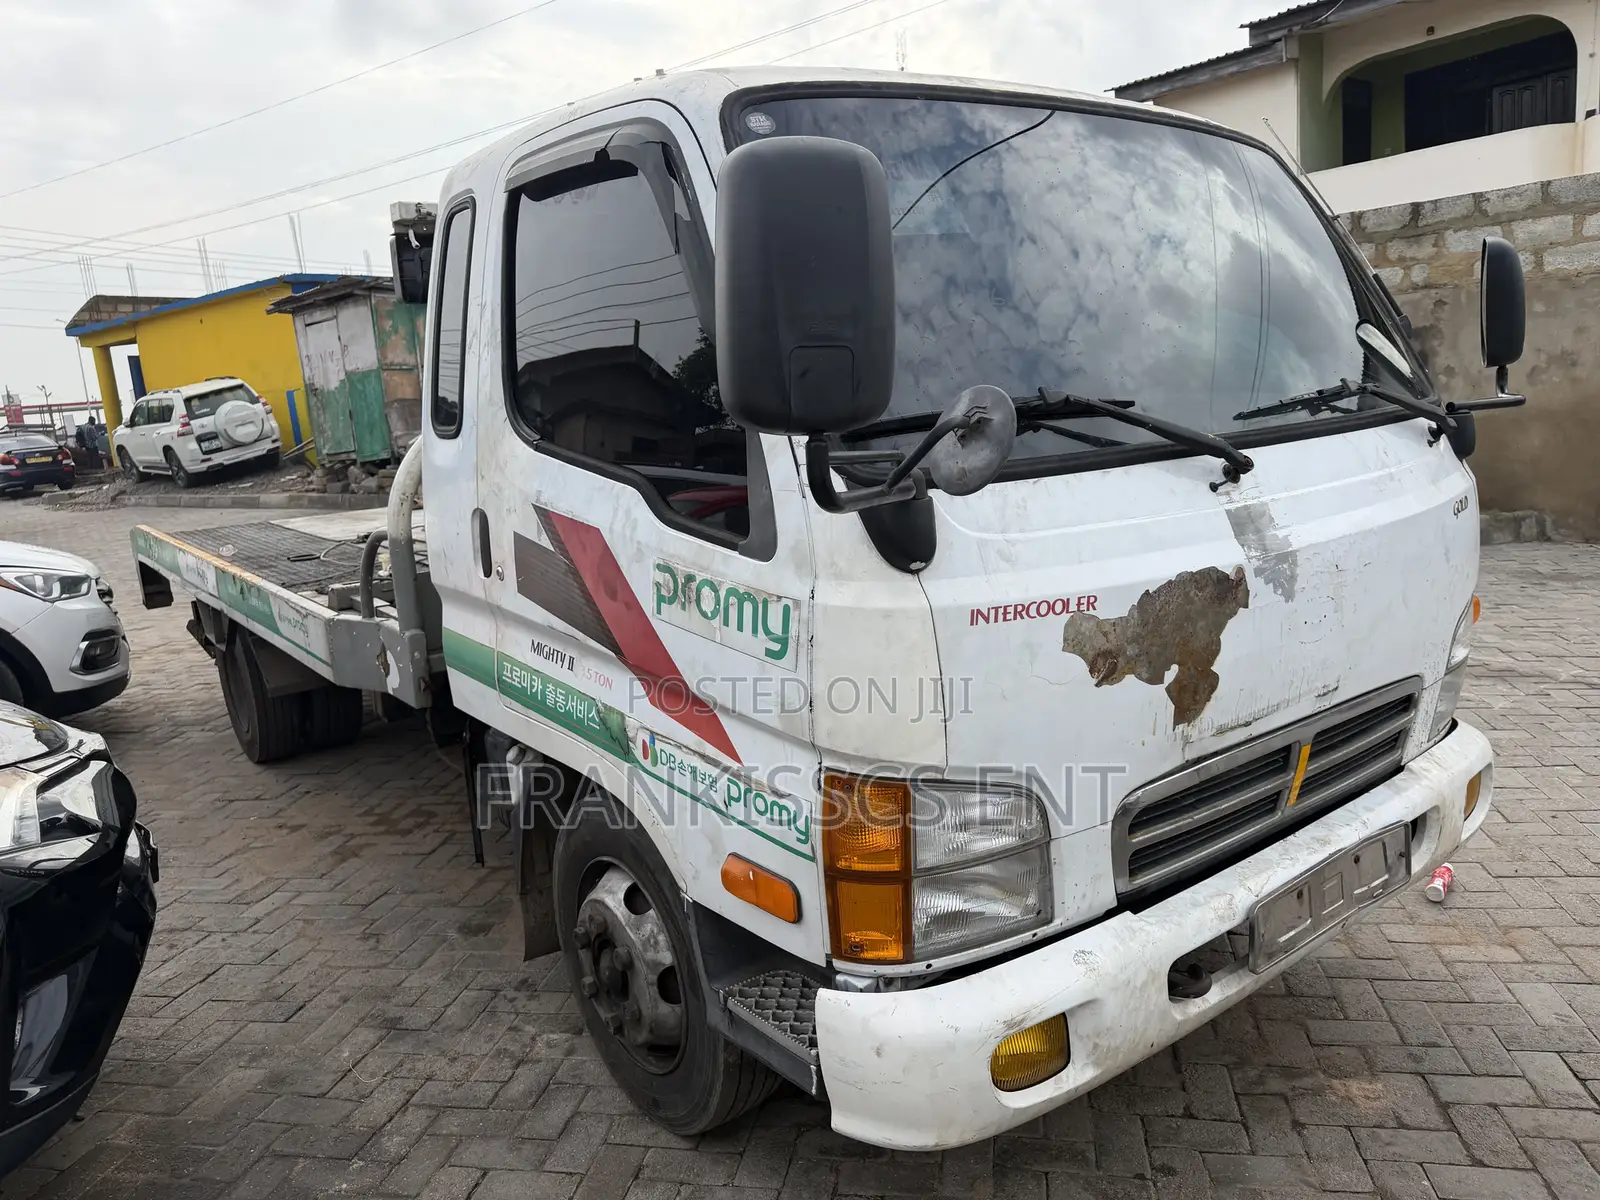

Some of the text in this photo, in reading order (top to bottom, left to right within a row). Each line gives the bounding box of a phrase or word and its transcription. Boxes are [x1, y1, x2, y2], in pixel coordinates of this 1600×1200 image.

[655, 562, 791, 660] promy
[969, 595, 1098, 626] INTERCOOLER
[530, 638, 566, 668] MIGHTY
[502, 661, 600, 729] 프로미카 출동서비스
[726, 777, 811, 845] promy
